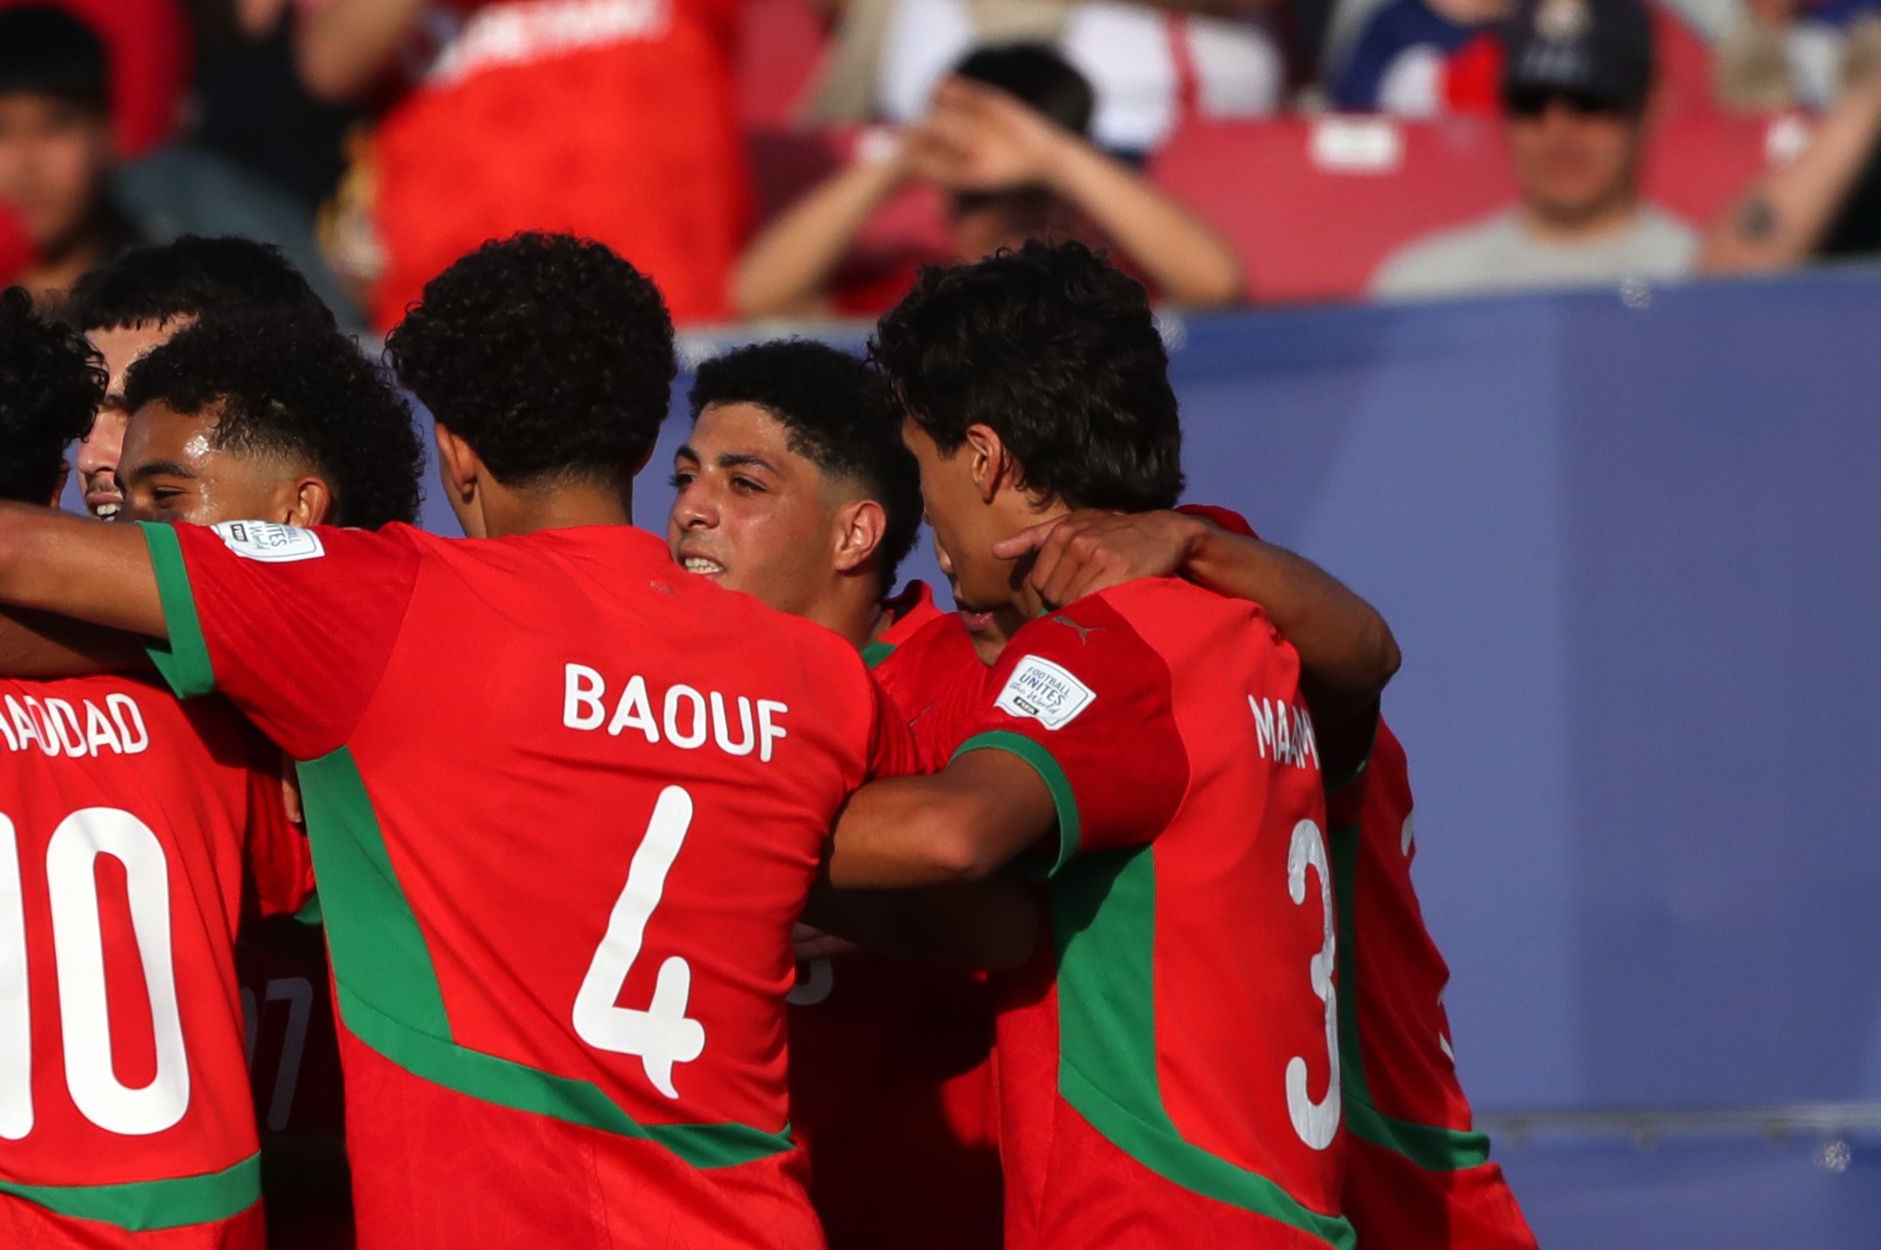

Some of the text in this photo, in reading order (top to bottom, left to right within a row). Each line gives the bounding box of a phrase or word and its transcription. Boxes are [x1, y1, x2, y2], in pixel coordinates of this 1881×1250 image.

[562, 662, 788, 762] BAOUF
[1018, 673, 1067, 706] UNITES
[1026, 666, 1071, 697] FOOTBALL
[572, 785, 705, 1100] 4
[1285, 819, 1341, 1151] 3
[241, 976, 313, 1132] 7
